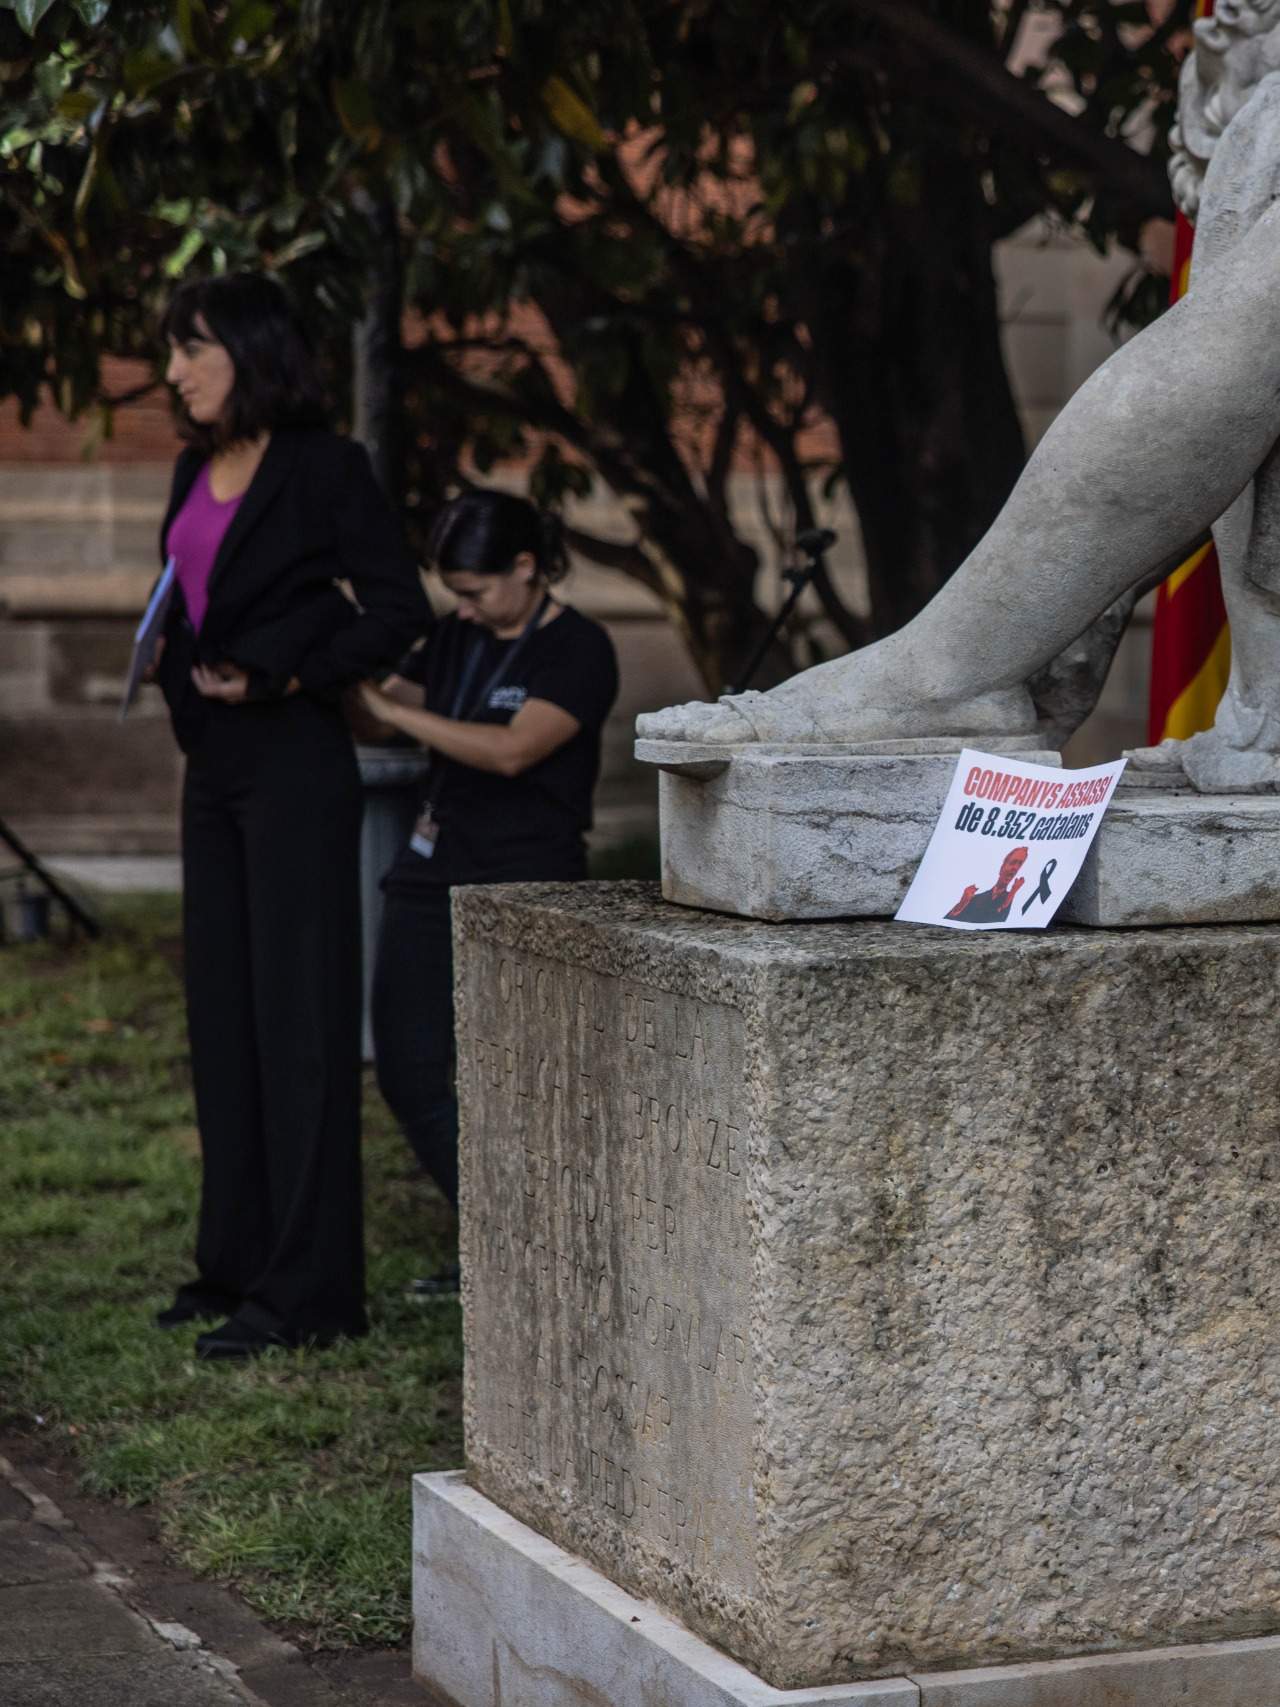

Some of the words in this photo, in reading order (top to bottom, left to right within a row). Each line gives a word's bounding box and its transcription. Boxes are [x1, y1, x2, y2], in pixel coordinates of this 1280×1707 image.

[955, 802, 984, 832] de
[981, 807, 1037, 839] 8.352
[1029, 812, 1094, 840] catalans
[964, 767, 1063, 809] COMPANYS
[498, 958, 605, 1033] ORIGINAL
[625, 993, 656, 1049] DE
[675, 1006, 707, 1064] LA
[633, 1091, 741, 1177] BRONZE
[632, 1192, 680, 1258] PER
